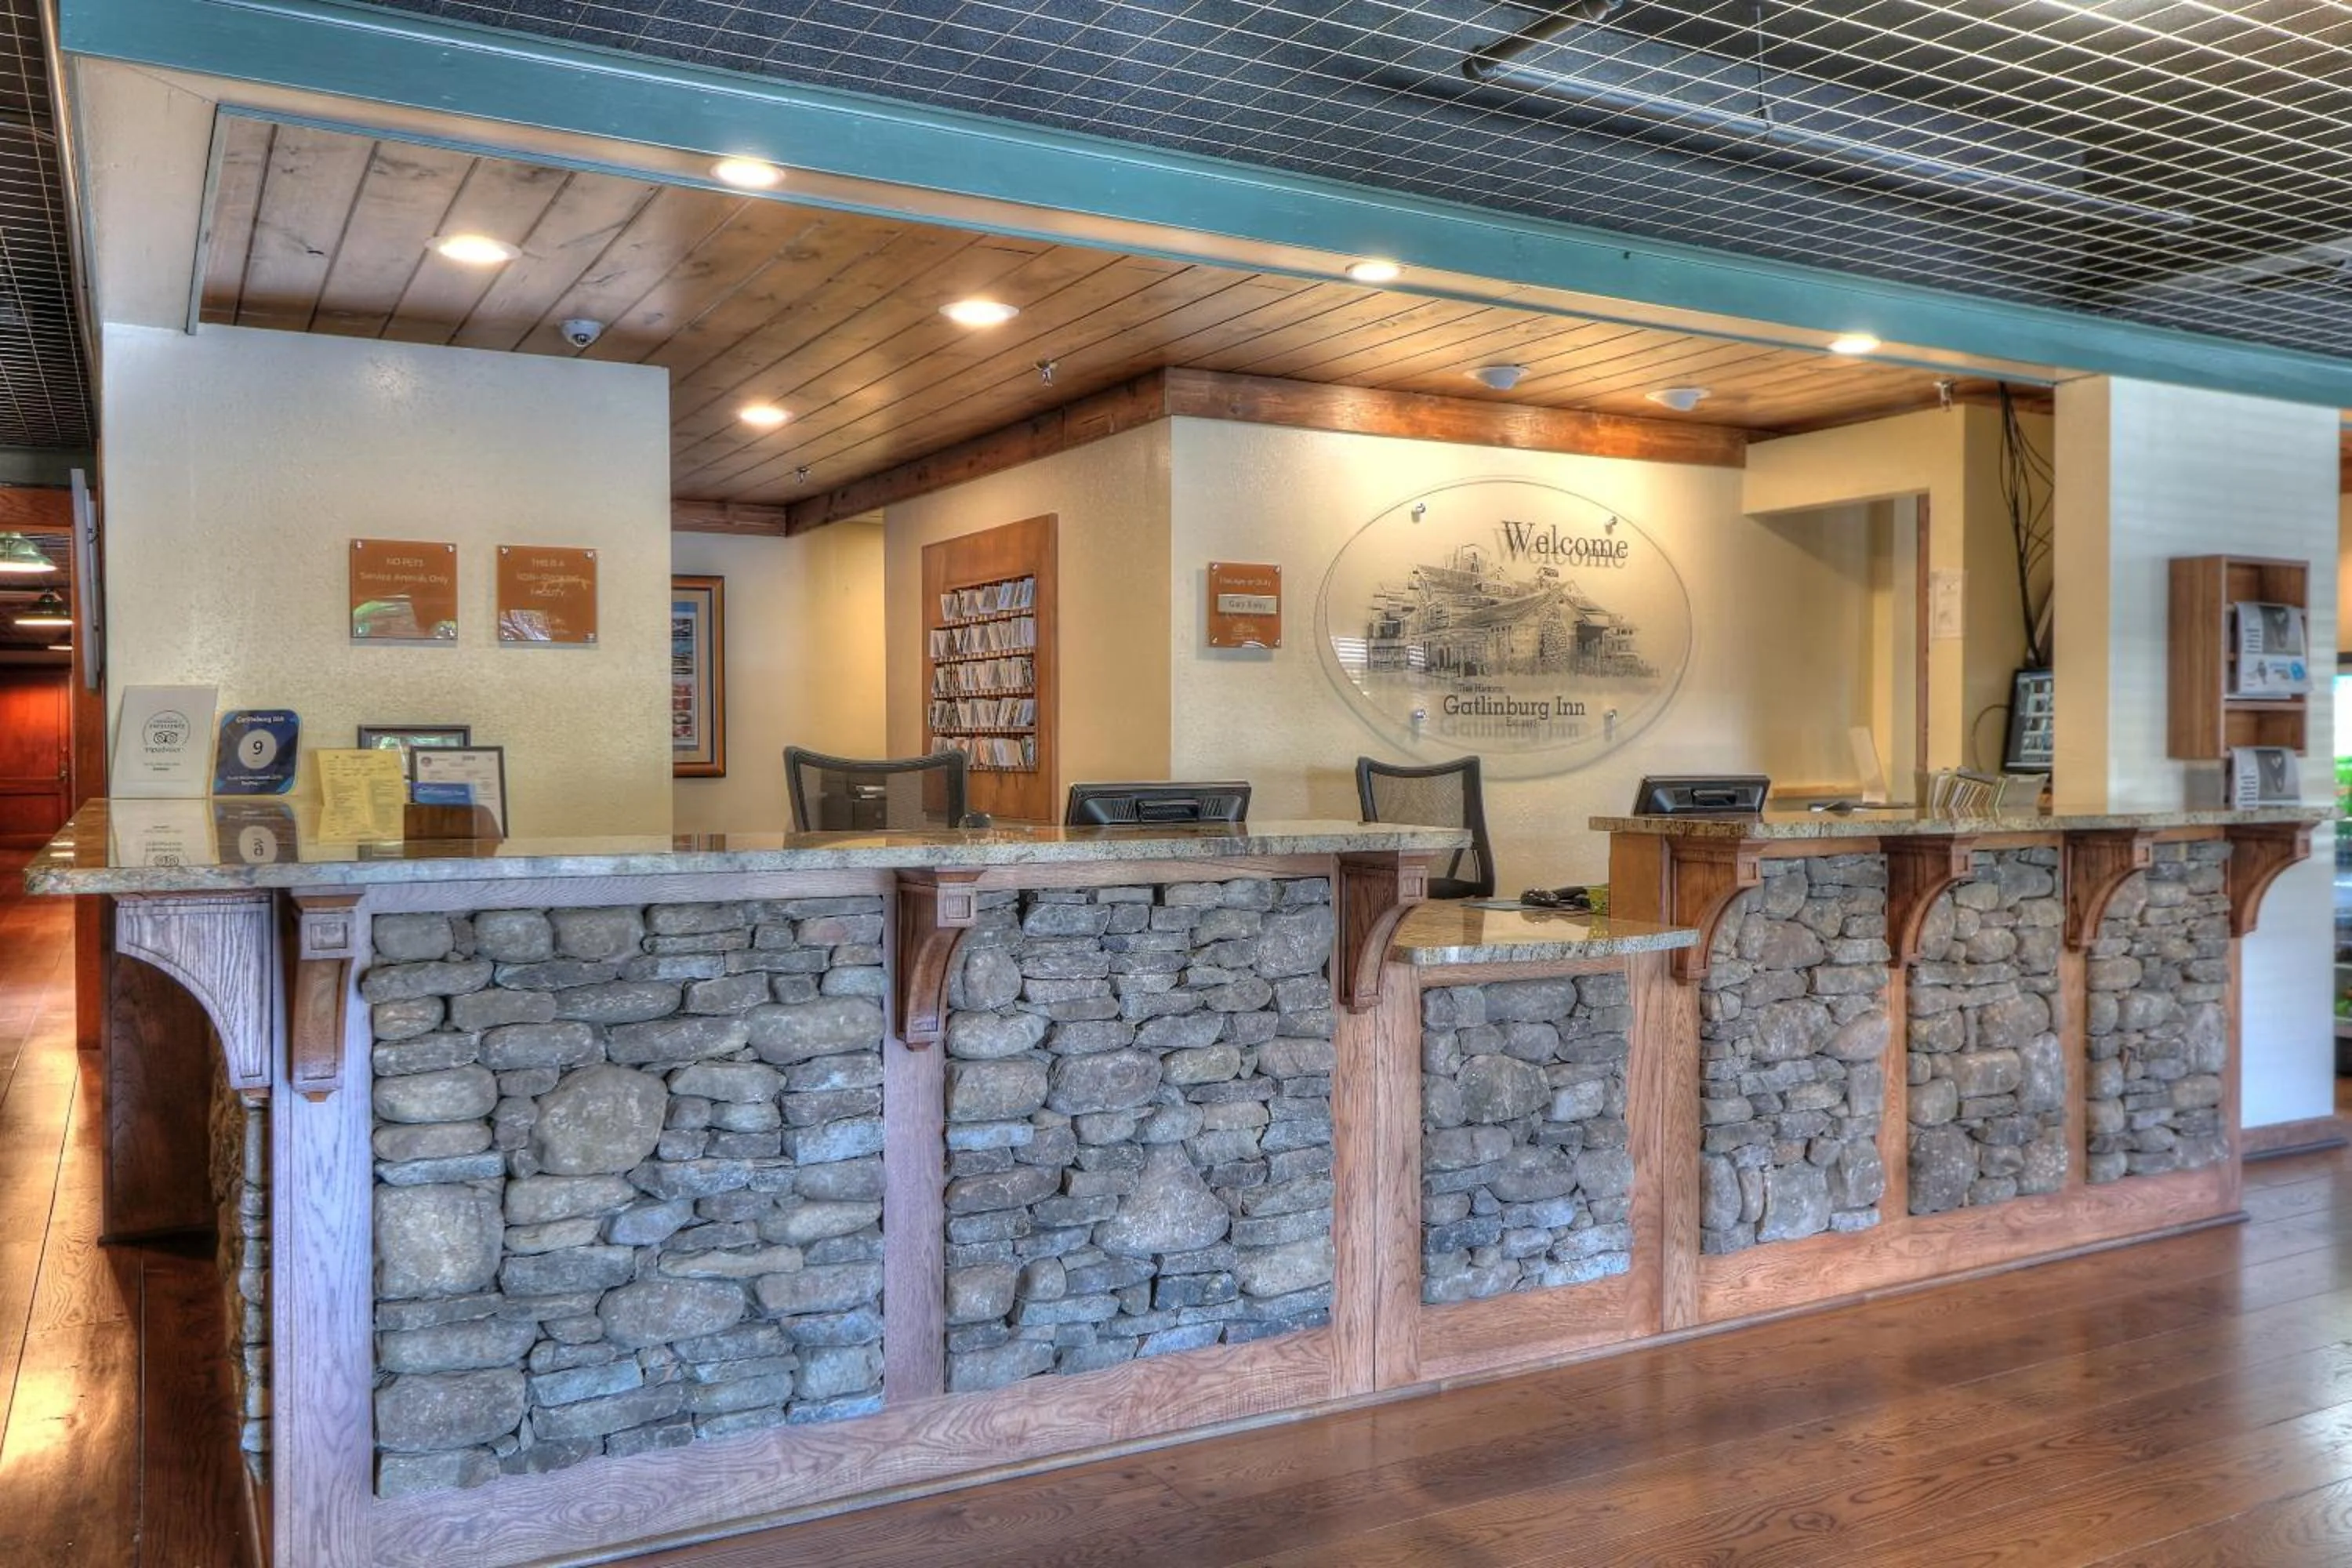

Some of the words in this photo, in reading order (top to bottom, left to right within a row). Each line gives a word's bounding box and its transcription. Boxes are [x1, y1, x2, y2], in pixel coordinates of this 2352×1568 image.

[1502, 520, 1628, 561] Welcome
[1443, 695, 1550, 720] Gatlinburg
[1555, 695, 1585, 716] Inn
[252, 740, 263, 755] 9
